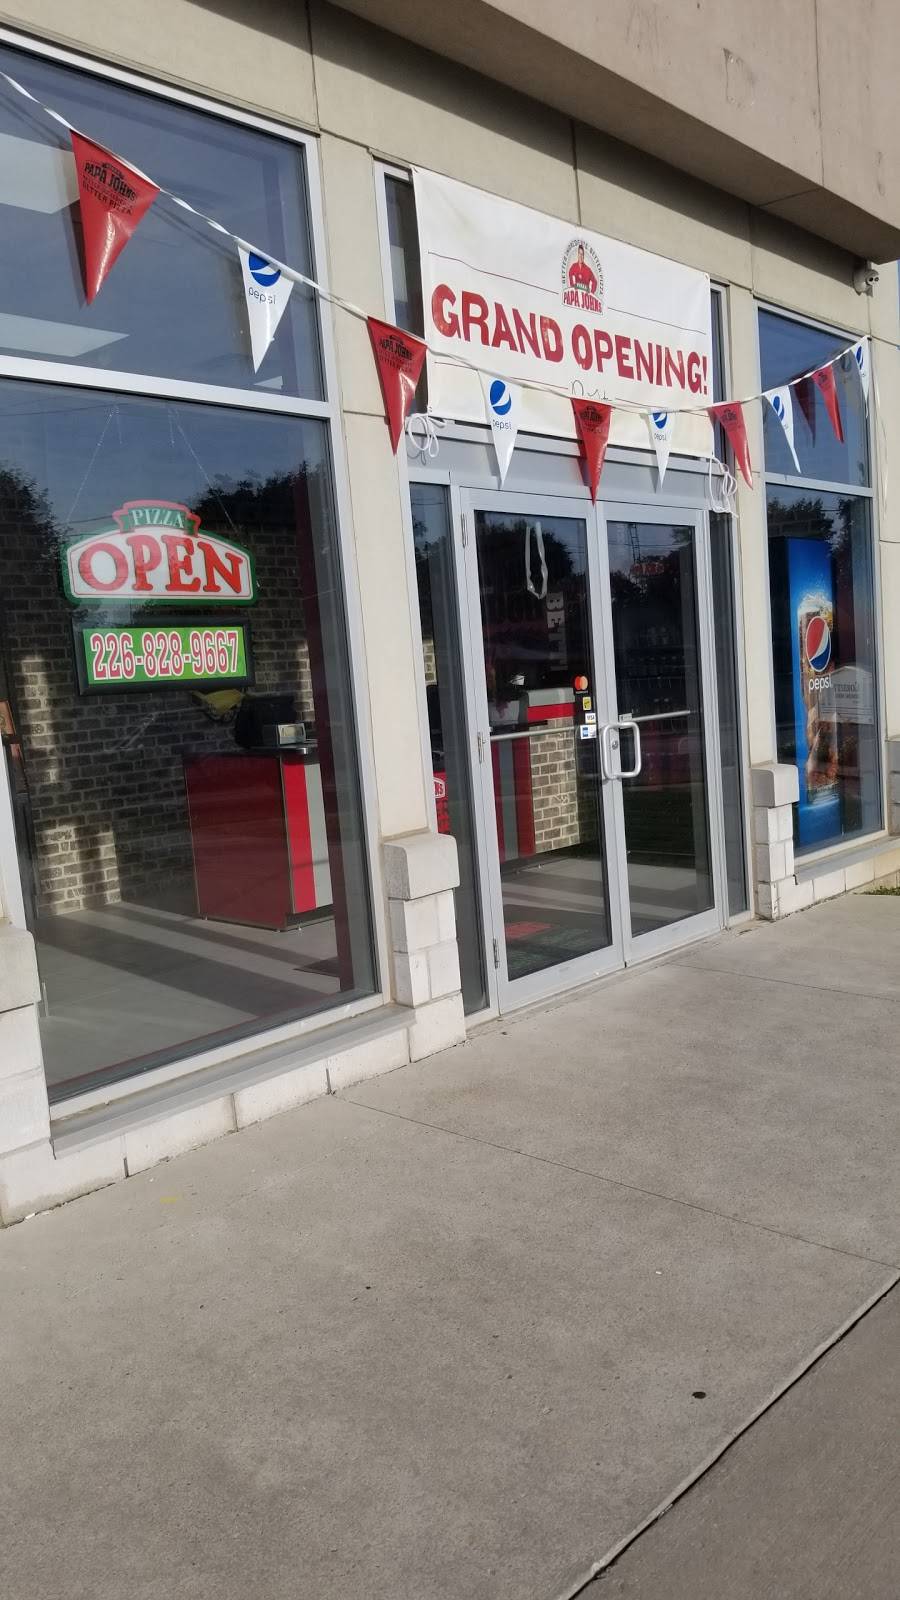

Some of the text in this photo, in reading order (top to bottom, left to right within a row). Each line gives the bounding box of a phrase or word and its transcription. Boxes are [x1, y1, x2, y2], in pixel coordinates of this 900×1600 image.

[84, 162, 107, 184] PAPA
[108, 173, 137, 201] JOHNS
[248, 287, 276, 304] pepsi
[563, 290, 602, 313] PAPA JOHNS
[431, 283, 708, 395] GRAND OPENING!
[131, 508, 185, 529] PIZZA
[78, 534, 244, 594] OPEN
[90, 630, 239, 681] 226-828-9667
[808, 674, 832, 693] pepsi
